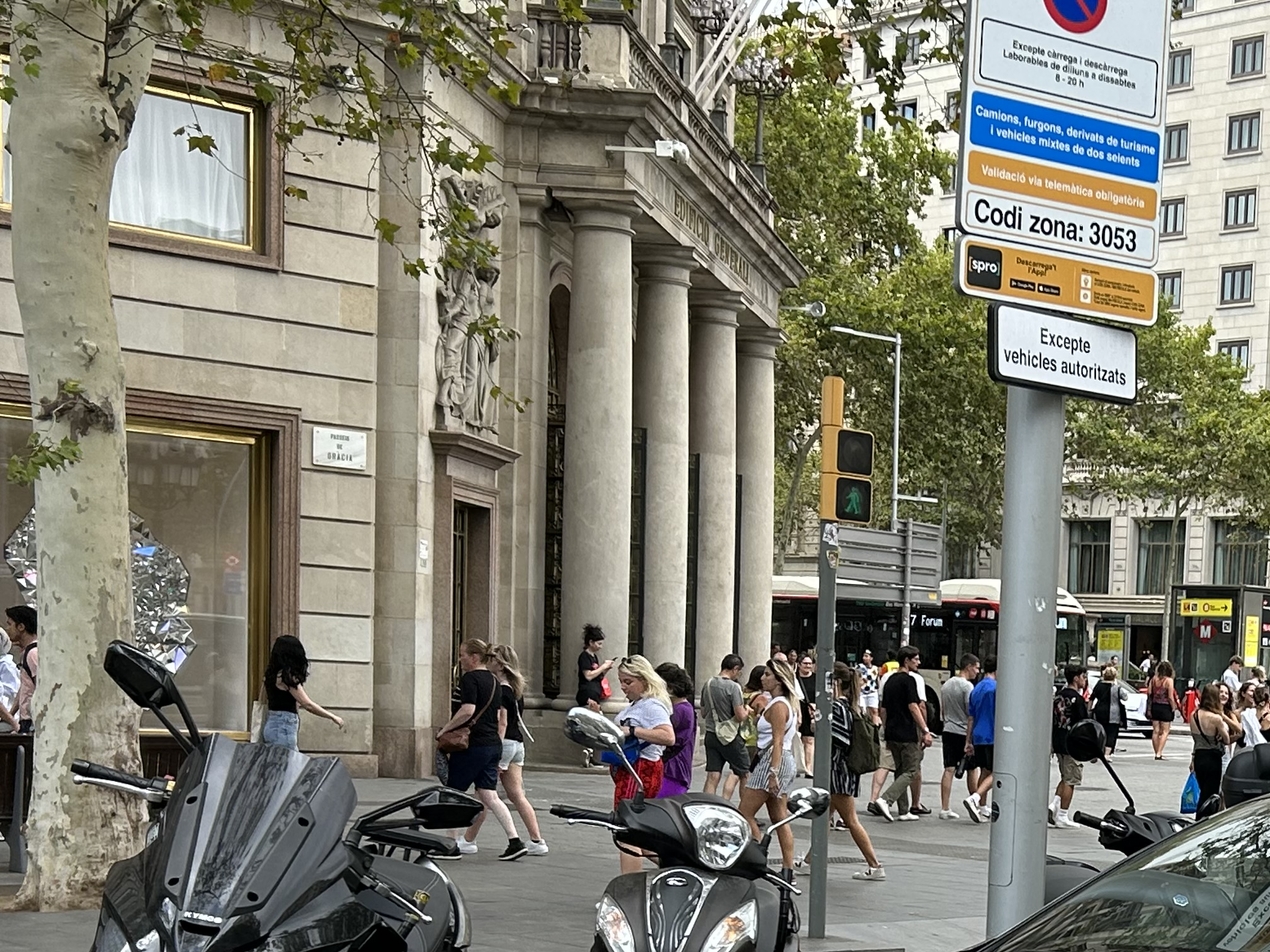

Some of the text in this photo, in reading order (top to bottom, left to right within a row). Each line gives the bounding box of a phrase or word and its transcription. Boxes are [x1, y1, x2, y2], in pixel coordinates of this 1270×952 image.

[1003, 49, 1048, 69] Laborables
[1050, 60, 1061, 72] de
[1062, 63, 1090, 79] dilluns
[1098, 71, 1136, 90] dissabtes
[1012, 39, 1045, 57] Excepte
[1047, 48, 1078, 65] càrrega
[1084, 56, 1128, 78] descàrrega
[1055, 74, 1060, 83] 8
[1067, 76, 1078, 87] 20
[975, 104, 1156, 156] Camions, furgons, derivats de turisme
[996, 126, 1036, 146] vehicles
[1038, 136, 1071, 153] mixtes
[1072, 142, 1085, 156] de
[1086, 146, 1104, 161] dos
[981, 163, 1145, 209] Validació via telemàtica obligatòria
[674, 189, 709, 247] EDIFICIO
[974, 198, 1137, 252] Codi zona: 3053
[1040, 327, 1091, 355] Excepte
[1004, 348, 1126, 386] vehicles autoritzats
[1200, 624, 1212, 639] M
[184, 911, 222, 924] KYMCO
